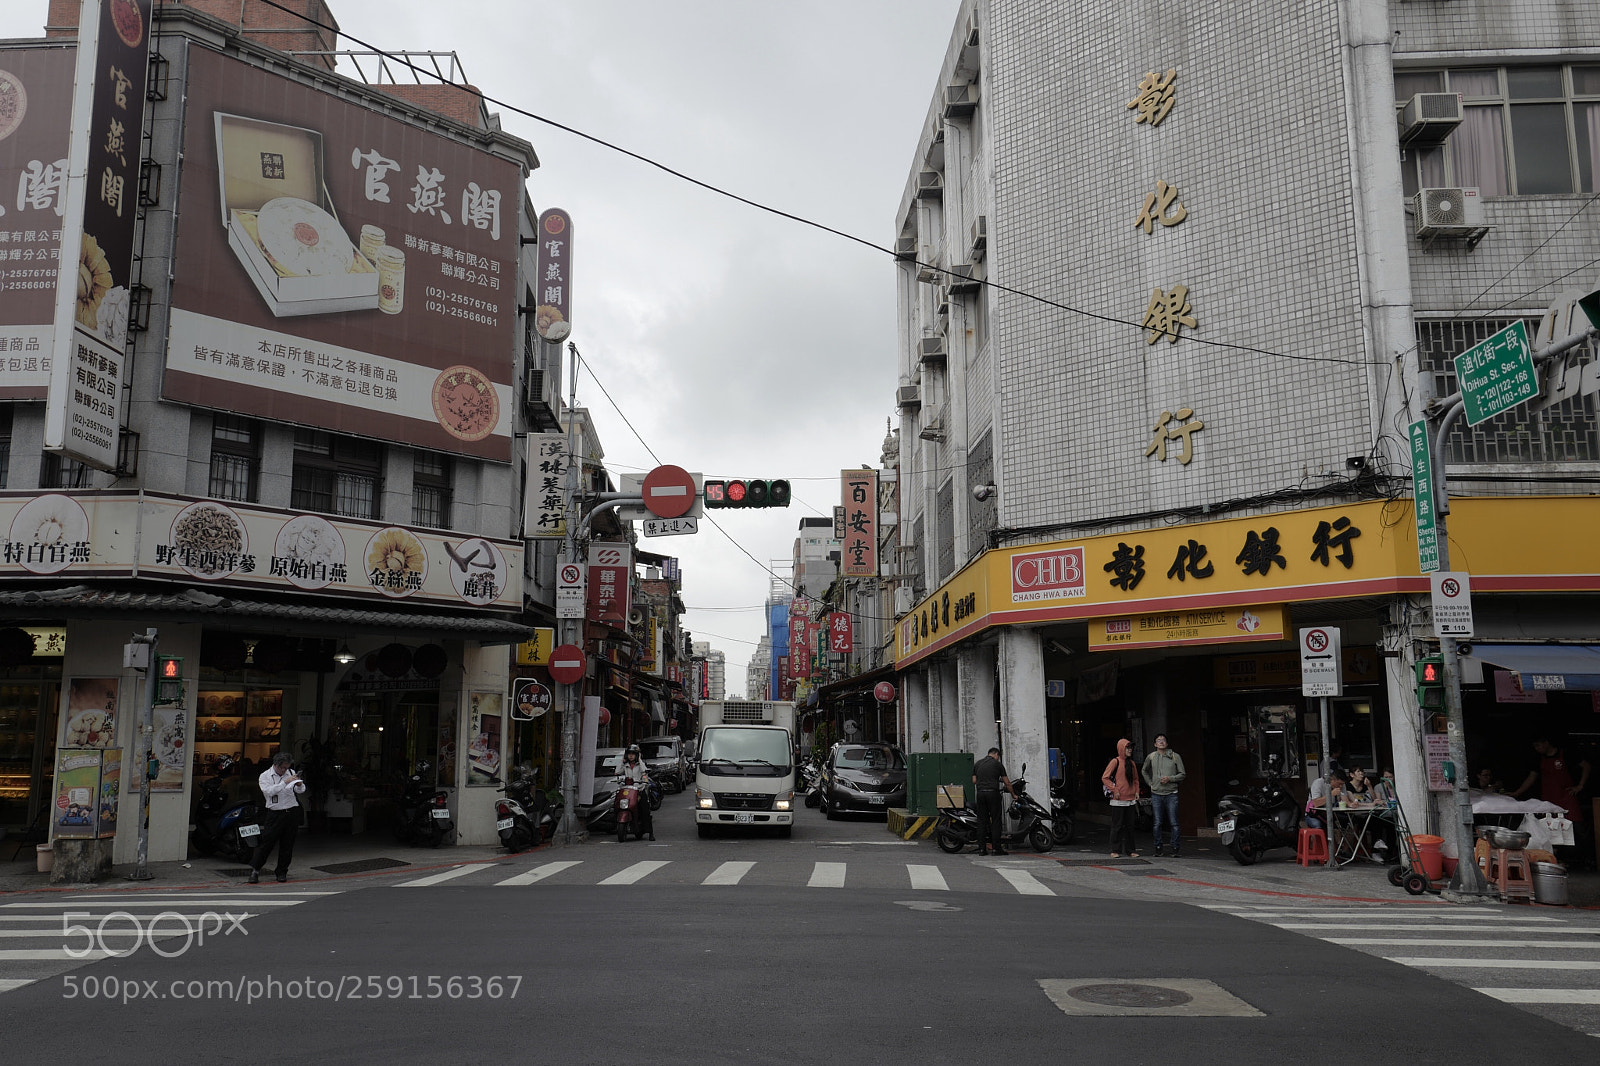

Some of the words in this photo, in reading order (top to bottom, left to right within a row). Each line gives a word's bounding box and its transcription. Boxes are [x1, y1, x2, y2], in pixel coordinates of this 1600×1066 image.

[101, 65, 133, 218] 官燕閣
[0, 158, 68, 218] 閣
[352, 147, 500, 240] 官燕閣
[441, 262, 500, 290] 聯輝分公司
[544, 239, 564, 305] 官燕閣
[1127, 68, 1204, 466] 彰化銀行
[425, 286, 498, 313] (02)-25576768
[425, 301, 498, 327] (02)-25566061
[258, 340, 398, 383] 本店所售出之各種商品
[1462, 329, 1519, 376] 迪化街一段
[76, 366, 117, 399] 有限公司
[1467, 376, 1489, 393] DiHua
[1489, 368, 1500, 379] St.
[1501, 361, 1518, 374] Sec.
[1519, 353, 1524, 364] 1
[74, 389, 115, 420] 聯輝分公司
[71, 426, 112, 450] (02)-25566061
[72, 412, 113, 438] (02)-25576768
[1414, 438, 1429, 516] 民生西路
[648, 520, 694, 535] 禁止進入
[847, 481, 871, 566] 百安堂
[1417, 518, 1427, 527] Min
[1418, 527, 1435, 537] Sheng
[4, 541, 91, 564] 特白官燕
[1103, 516, 1362, 592] 彰化銀行
[269, 555, 347, 583] 原始白燕
[369, 567, 422, 591] 金絲燕
[1014, 553, 1081, 588] CHB
[463, 579, 496, 600] 鹿茸
[1012, 591, 1041, 602] CHANG
[1043, 590, 1061, 600] HWA
[1063, 588, 1085, 598] BANK
[833, 616, 849, 650] 德元
[1107, 620, 1131, 633] CHB
[1140, 615, 1180, 628] 自動化服務
